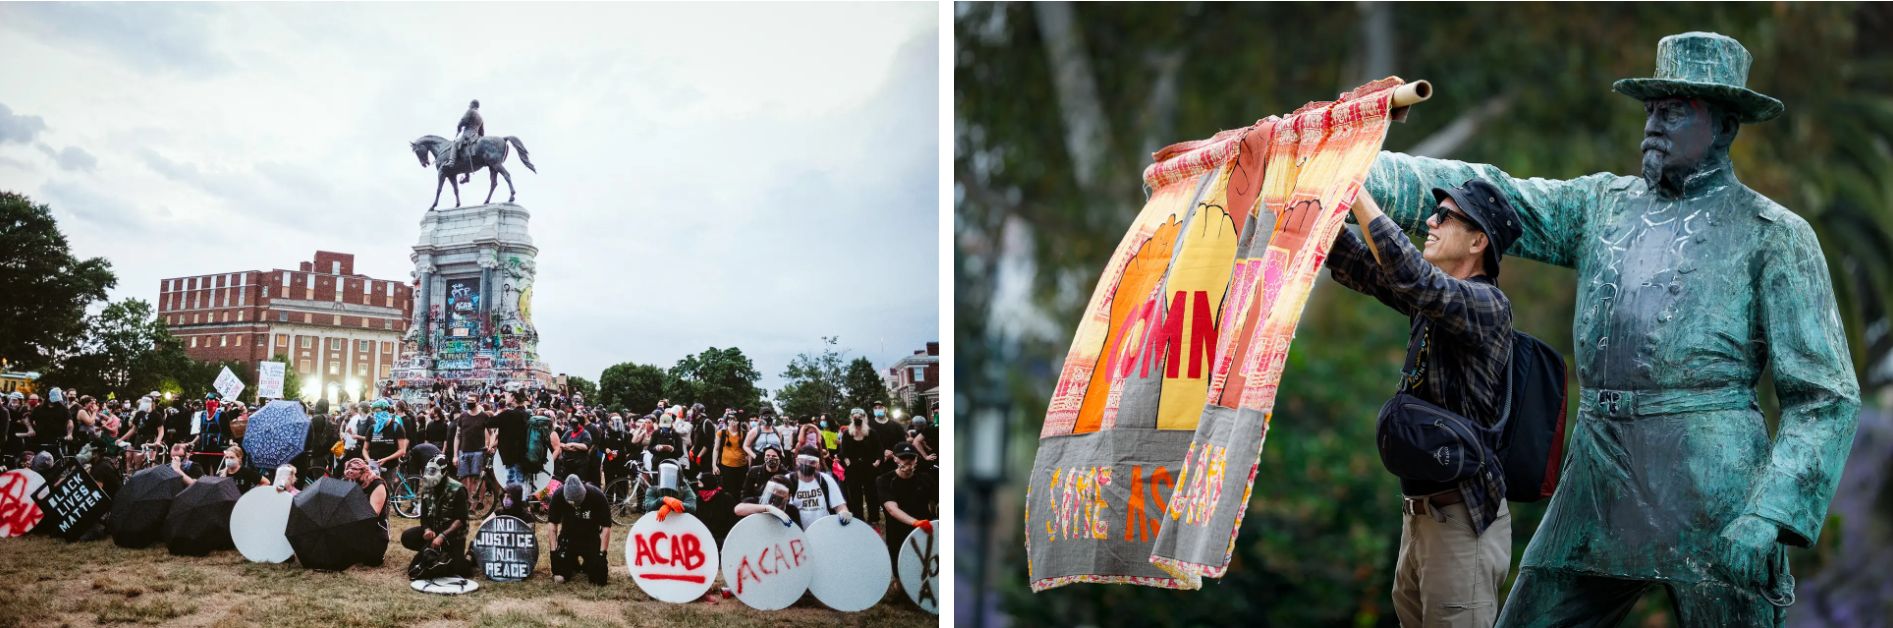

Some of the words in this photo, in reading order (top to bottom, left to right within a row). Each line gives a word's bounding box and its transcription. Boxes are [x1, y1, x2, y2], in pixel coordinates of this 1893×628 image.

[48, 473, 84, 508] BLACK
[57, 485, 89, 516] LIVES
[59, 490, 102, 532] MATTER
[496, 518, 515, 532] NO
[476, 532, 533, 547] JUSTICE
[496, 548, 514, 561] NO
[634, 531, 706, 571] ACAB
[485, 562, 528, 578] PEACE
[737, 538, 806, 594] ACAB
